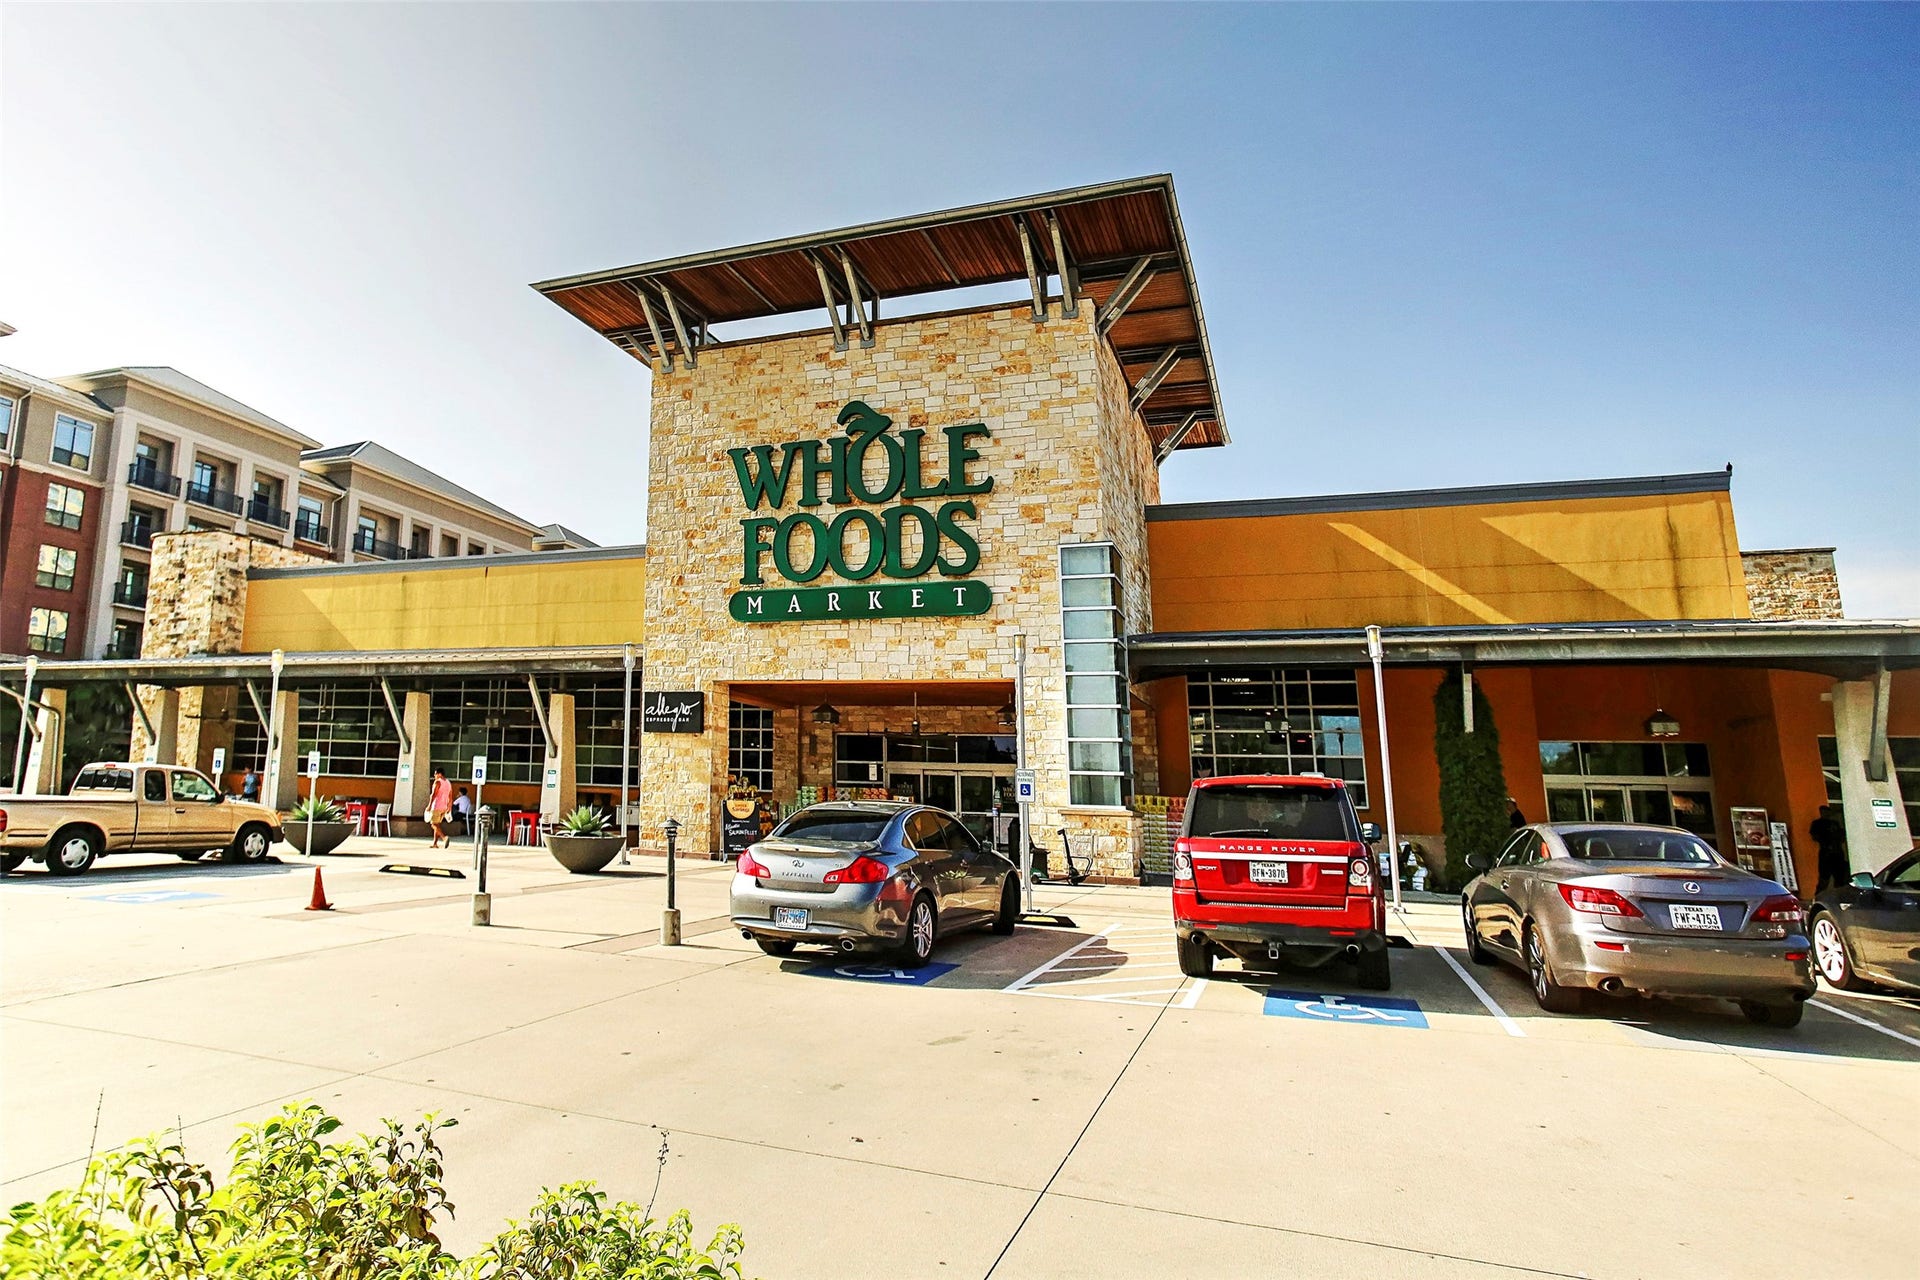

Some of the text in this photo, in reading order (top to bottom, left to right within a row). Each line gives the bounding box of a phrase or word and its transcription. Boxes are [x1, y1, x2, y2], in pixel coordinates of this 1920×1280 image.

[727, 421, 994, 511] WHOLE
[740, 500, 981, 585] FOODS
[746, 587, 968, 615] MARKET
[645, 692, 700, 732] allegro
